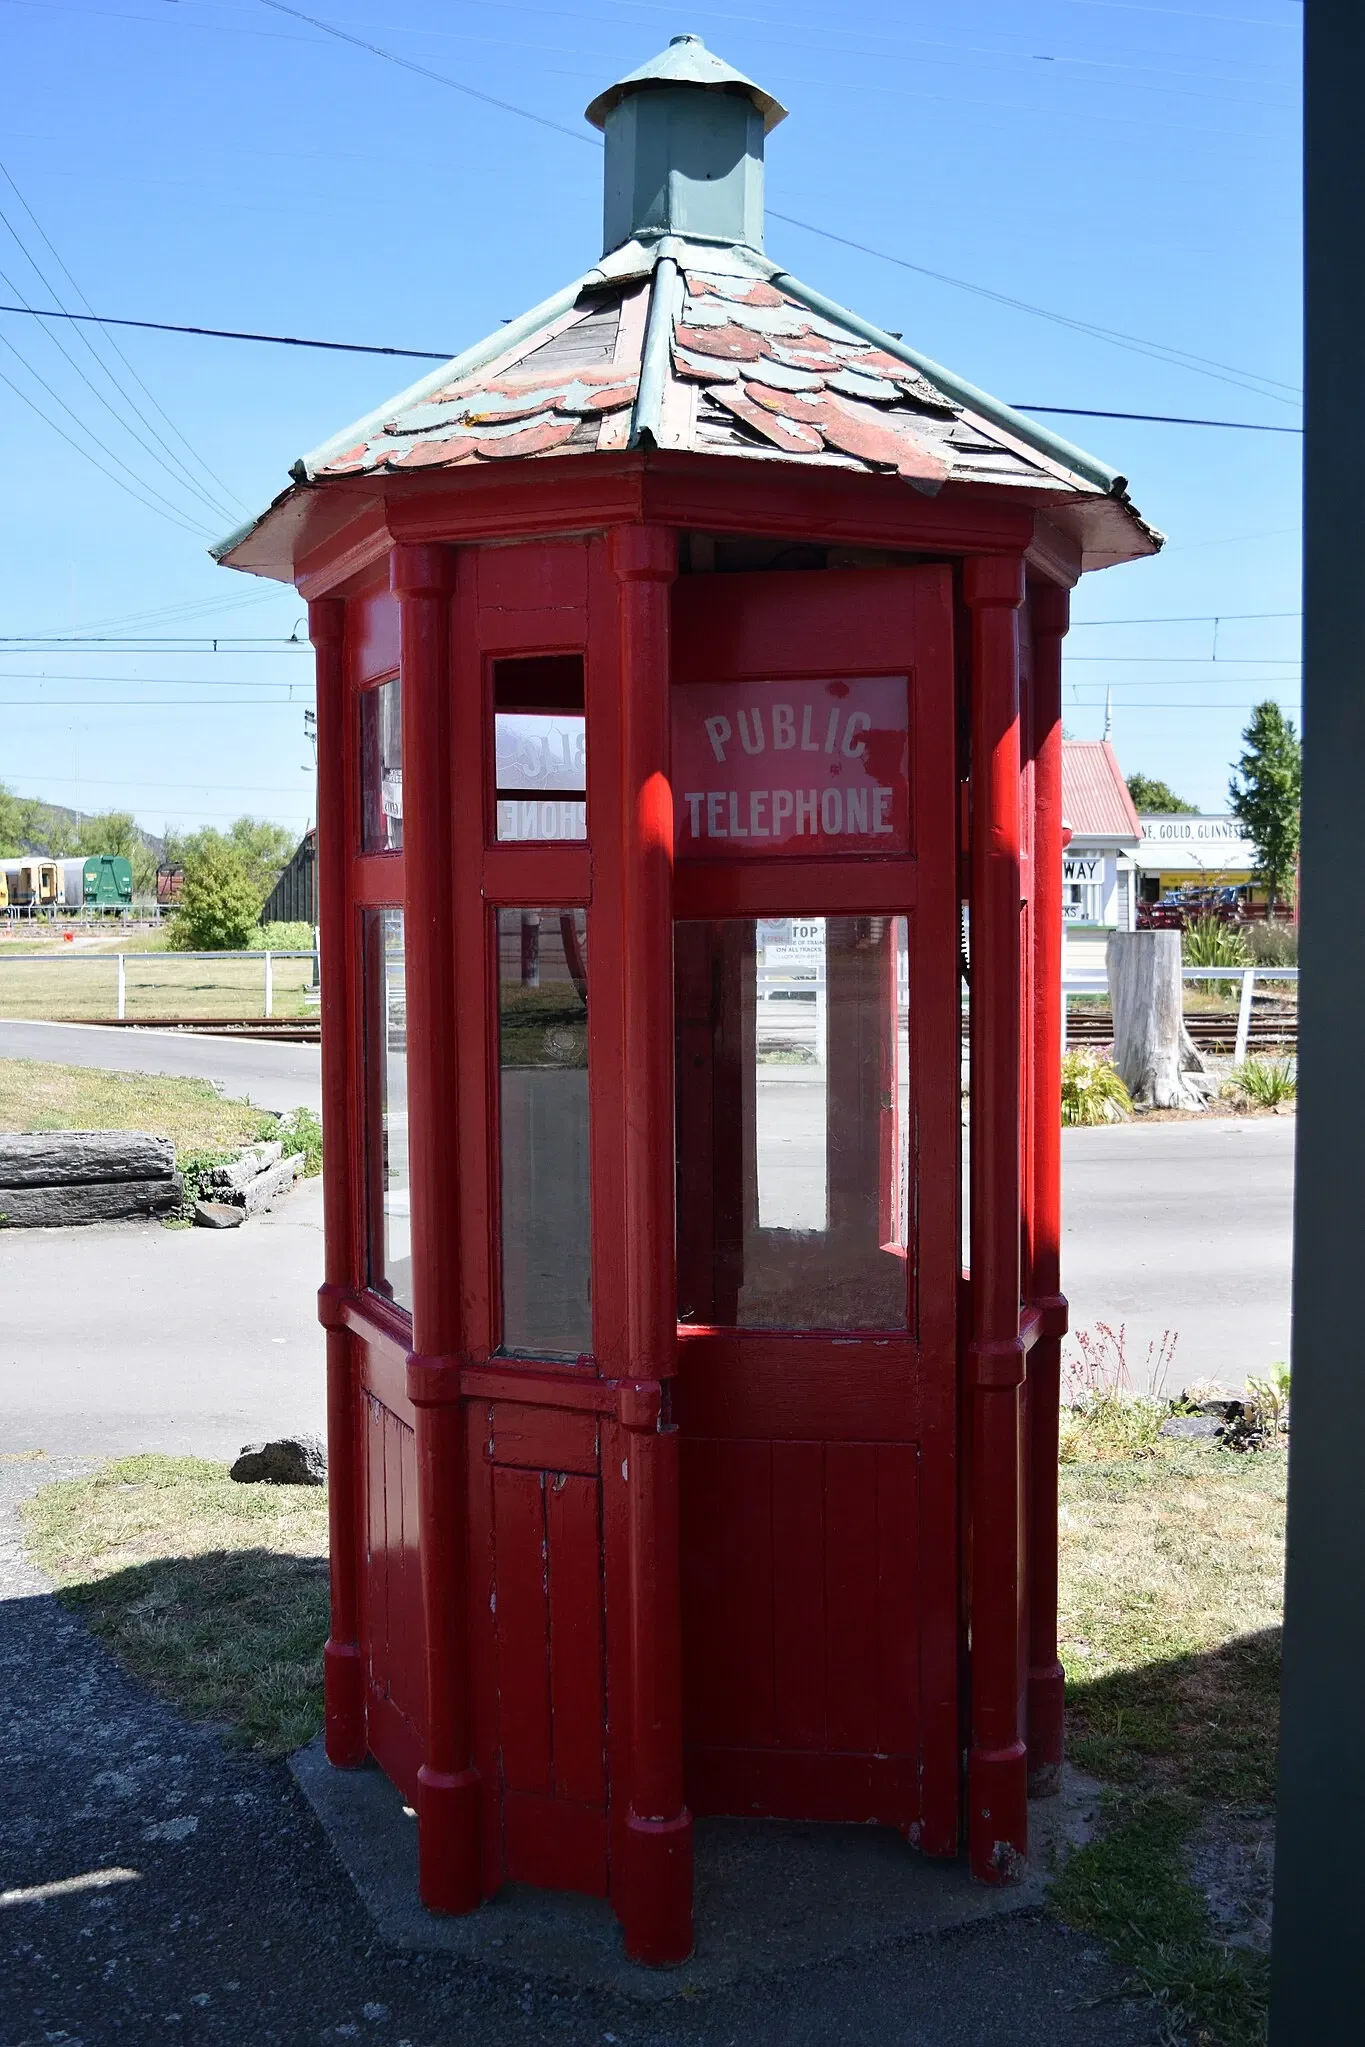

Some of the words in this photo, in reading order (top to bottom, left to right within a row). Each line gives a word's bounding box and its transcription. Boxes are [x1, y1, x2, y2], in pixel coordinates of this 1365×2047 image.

[704, 704, 872, 763] PUBLIC
[685, 787, 893, 837] TELEPHONE
[1063, 862, 1096, 879] WAY
[793, 926, 818, 938] TOP
